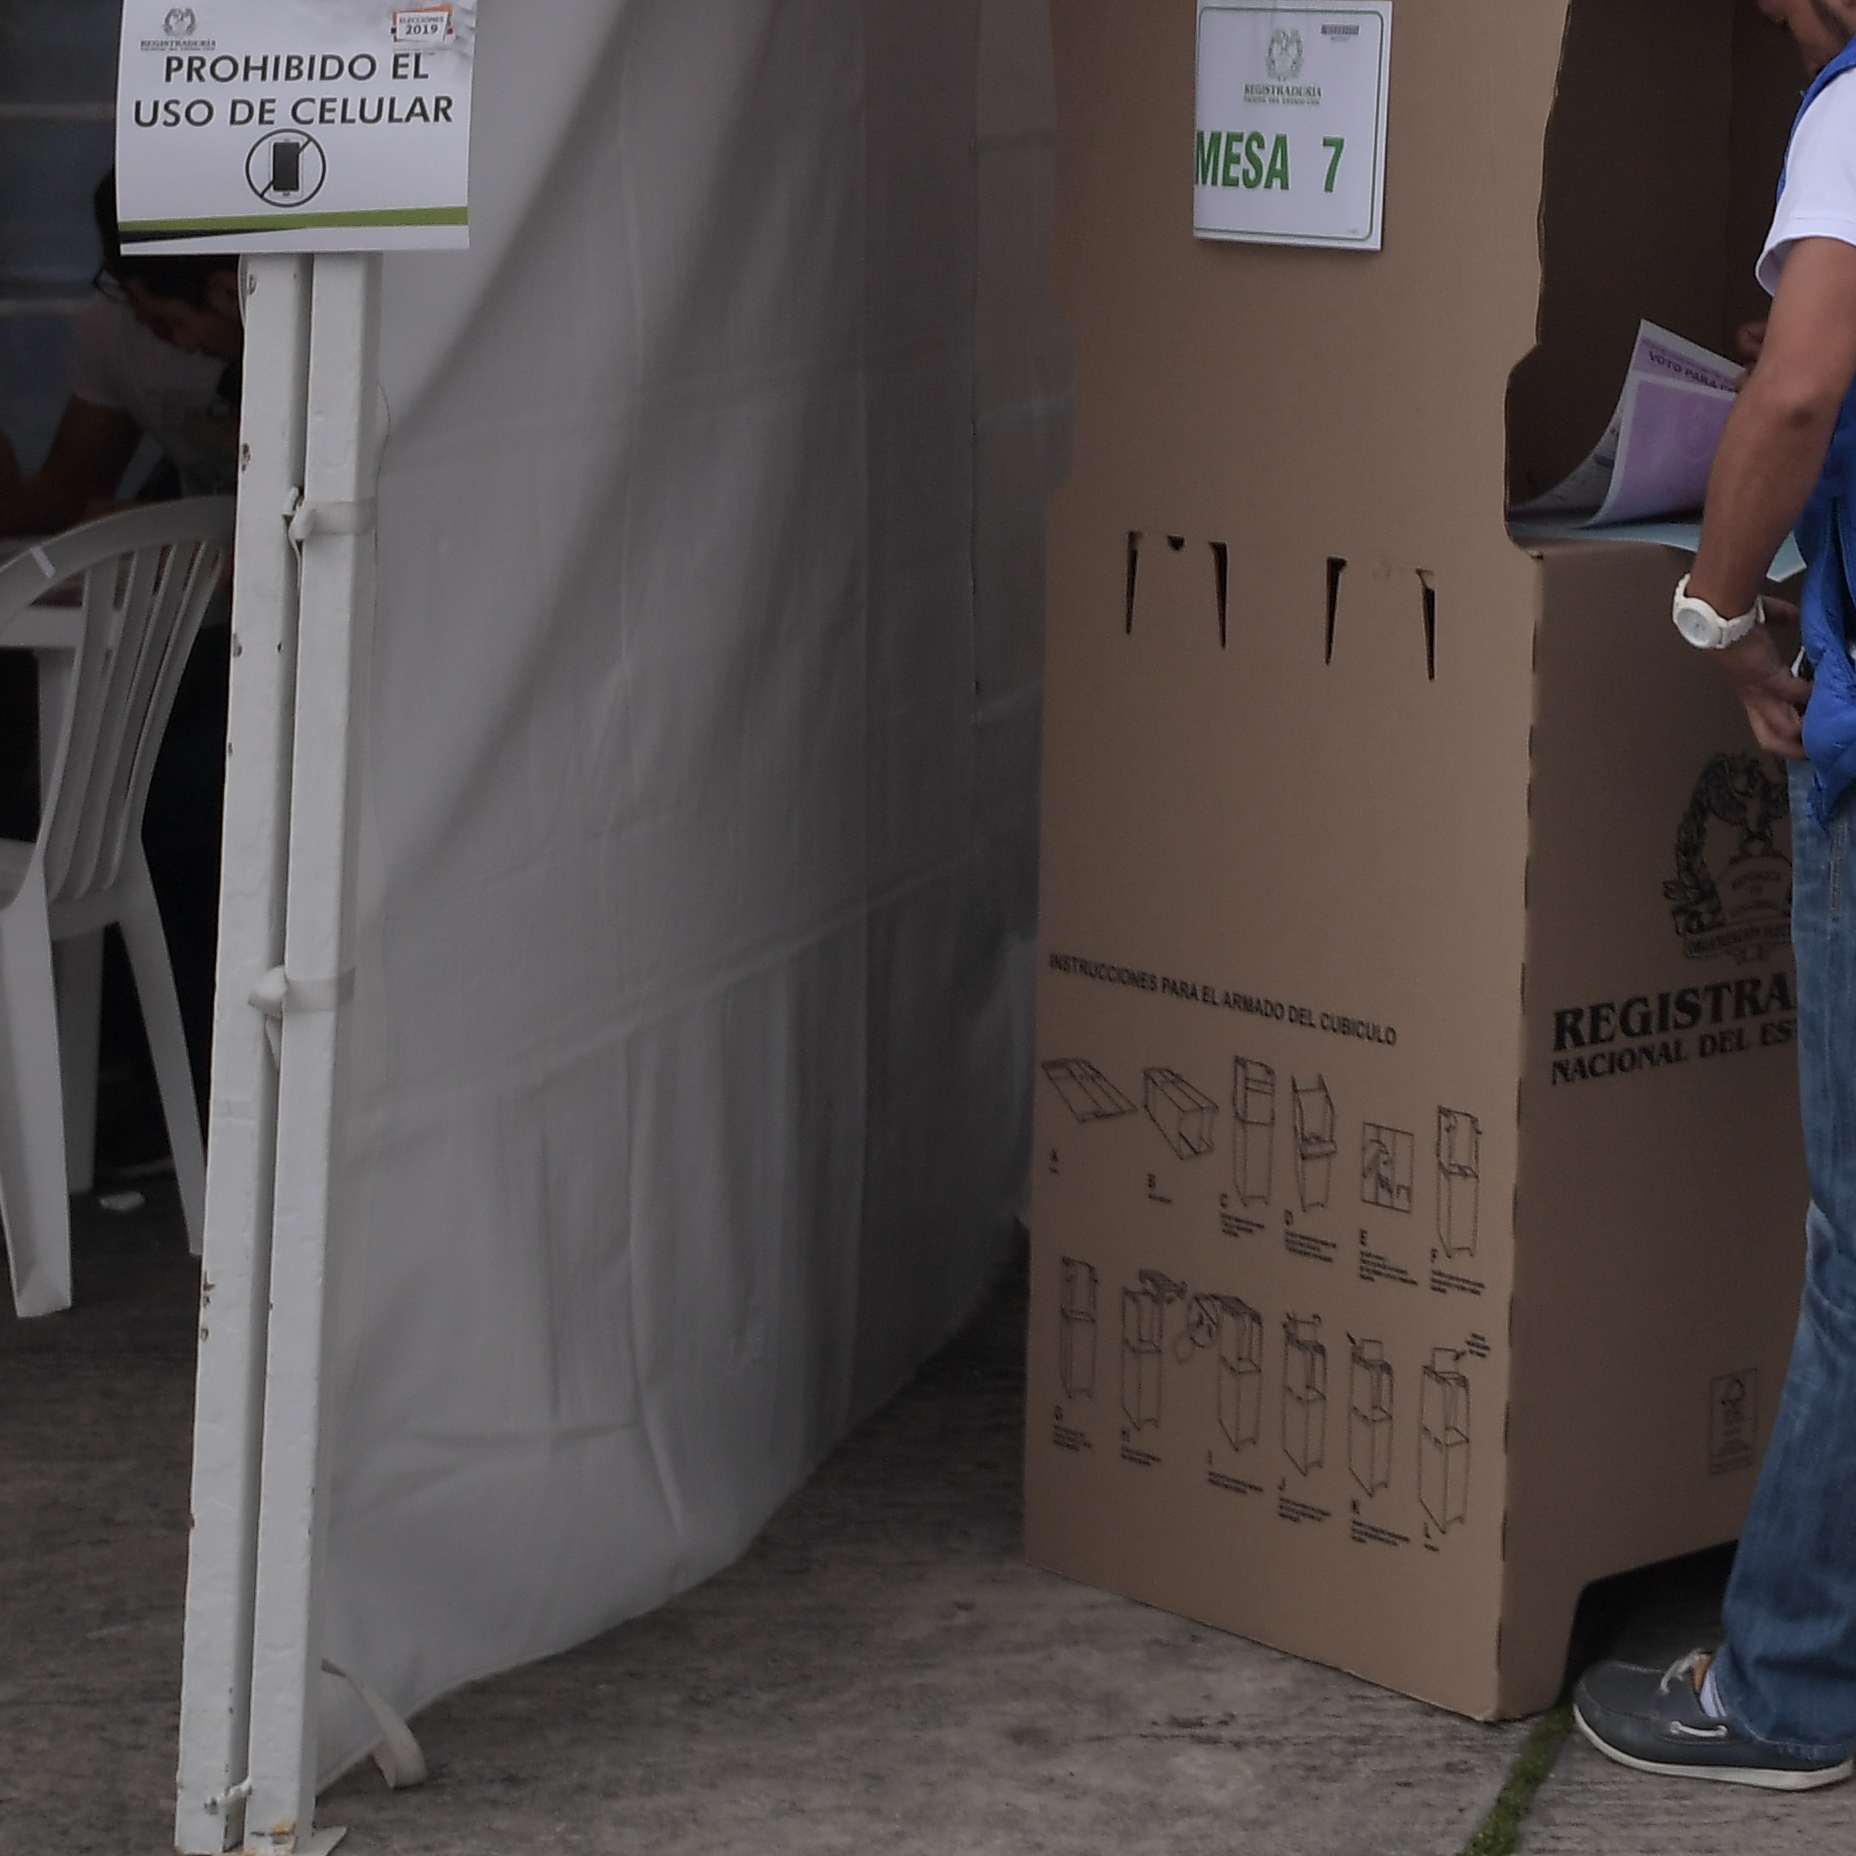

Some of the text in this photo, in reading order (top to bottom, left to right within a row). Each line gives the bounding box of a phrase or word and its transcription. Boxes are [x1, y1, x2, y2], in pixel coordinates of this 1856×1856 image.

[405, 23, 438, 35] 2019
[164, 52, 429, 83] PROHIBIDO EL
[134, 95, 454, 127] USO DE CELULAR
[1195, 130, 1345, 193] MESA 7
[1648, 350, 1682, 373] VOTO
[1685, 368, 1718, 389] PARA
[1048, 952, 1158, 993] INSTRUCCIONES
[1160, 975, 1199, 1002] PARA
[1201, 984, 1219, 1007] EL
[1223, 990, 1286, 1022] ARMADO
[1287, 1004, 1317, 1028] DEL
[1551, 1017, 1796, 1085] NACIONAL DEL ES
